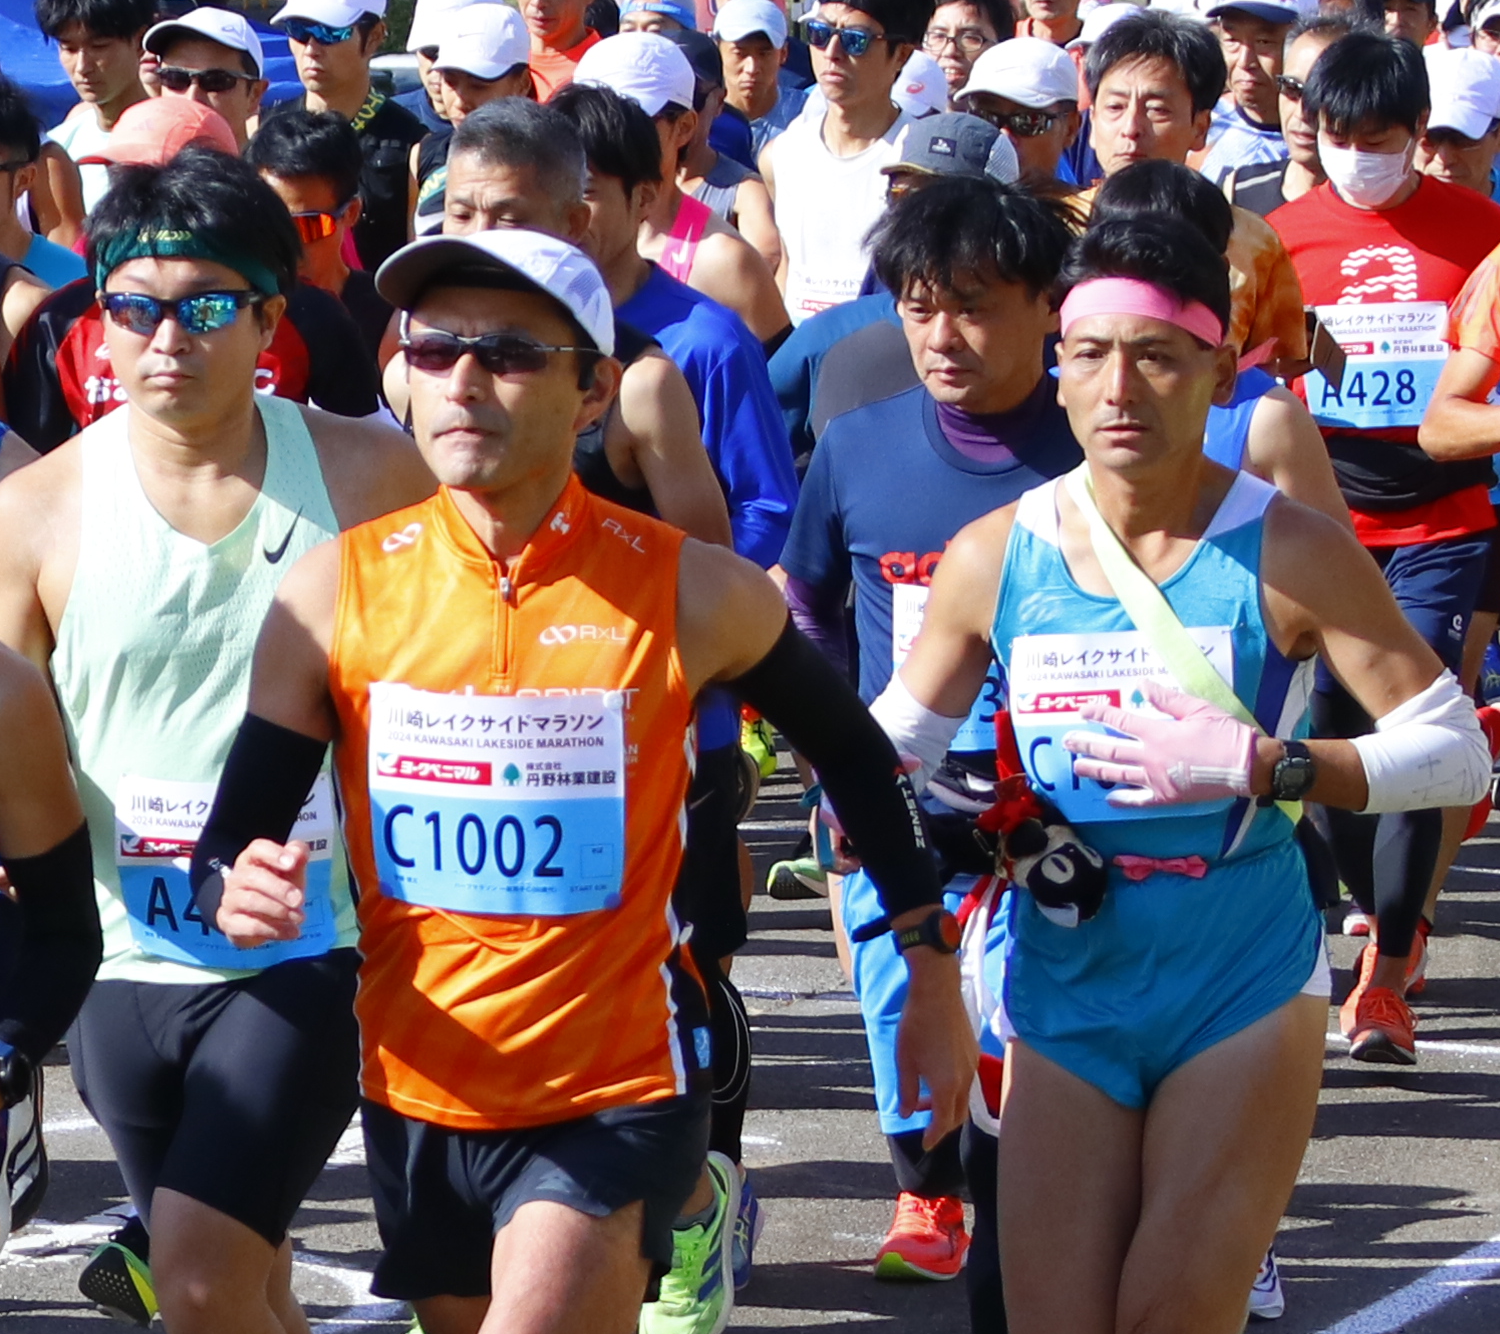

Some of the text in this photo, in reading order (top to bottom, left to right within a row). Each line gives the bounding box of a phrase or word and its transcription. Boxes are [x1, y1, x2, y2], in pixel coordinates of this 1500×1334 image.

[1323, 312, 1437, 328] 崎レイクサイドマラソン
[1320, 369, 1417, 408] A428
[1050, 671, 1104, 680] KAWASAKI
[1106, 668, 1155, 678] LAKESIDE
[387, 707, 604, 734] 川崎レイクサイドマラソン
[413, 734, 473, 747] KAWASAKI
[476, 736, 534, 749] LAKESIDE
[536, 736, 604, 749] MARATHON
[398, 762, 480, 781] ヨークベニマル
[526, 762, 562, 771] 株式会社
[526, 771, 616, 787] 丹野林業建設
[155, 817, 205, 828] KAWASAK
[383, 804, 565, 878] C1002
